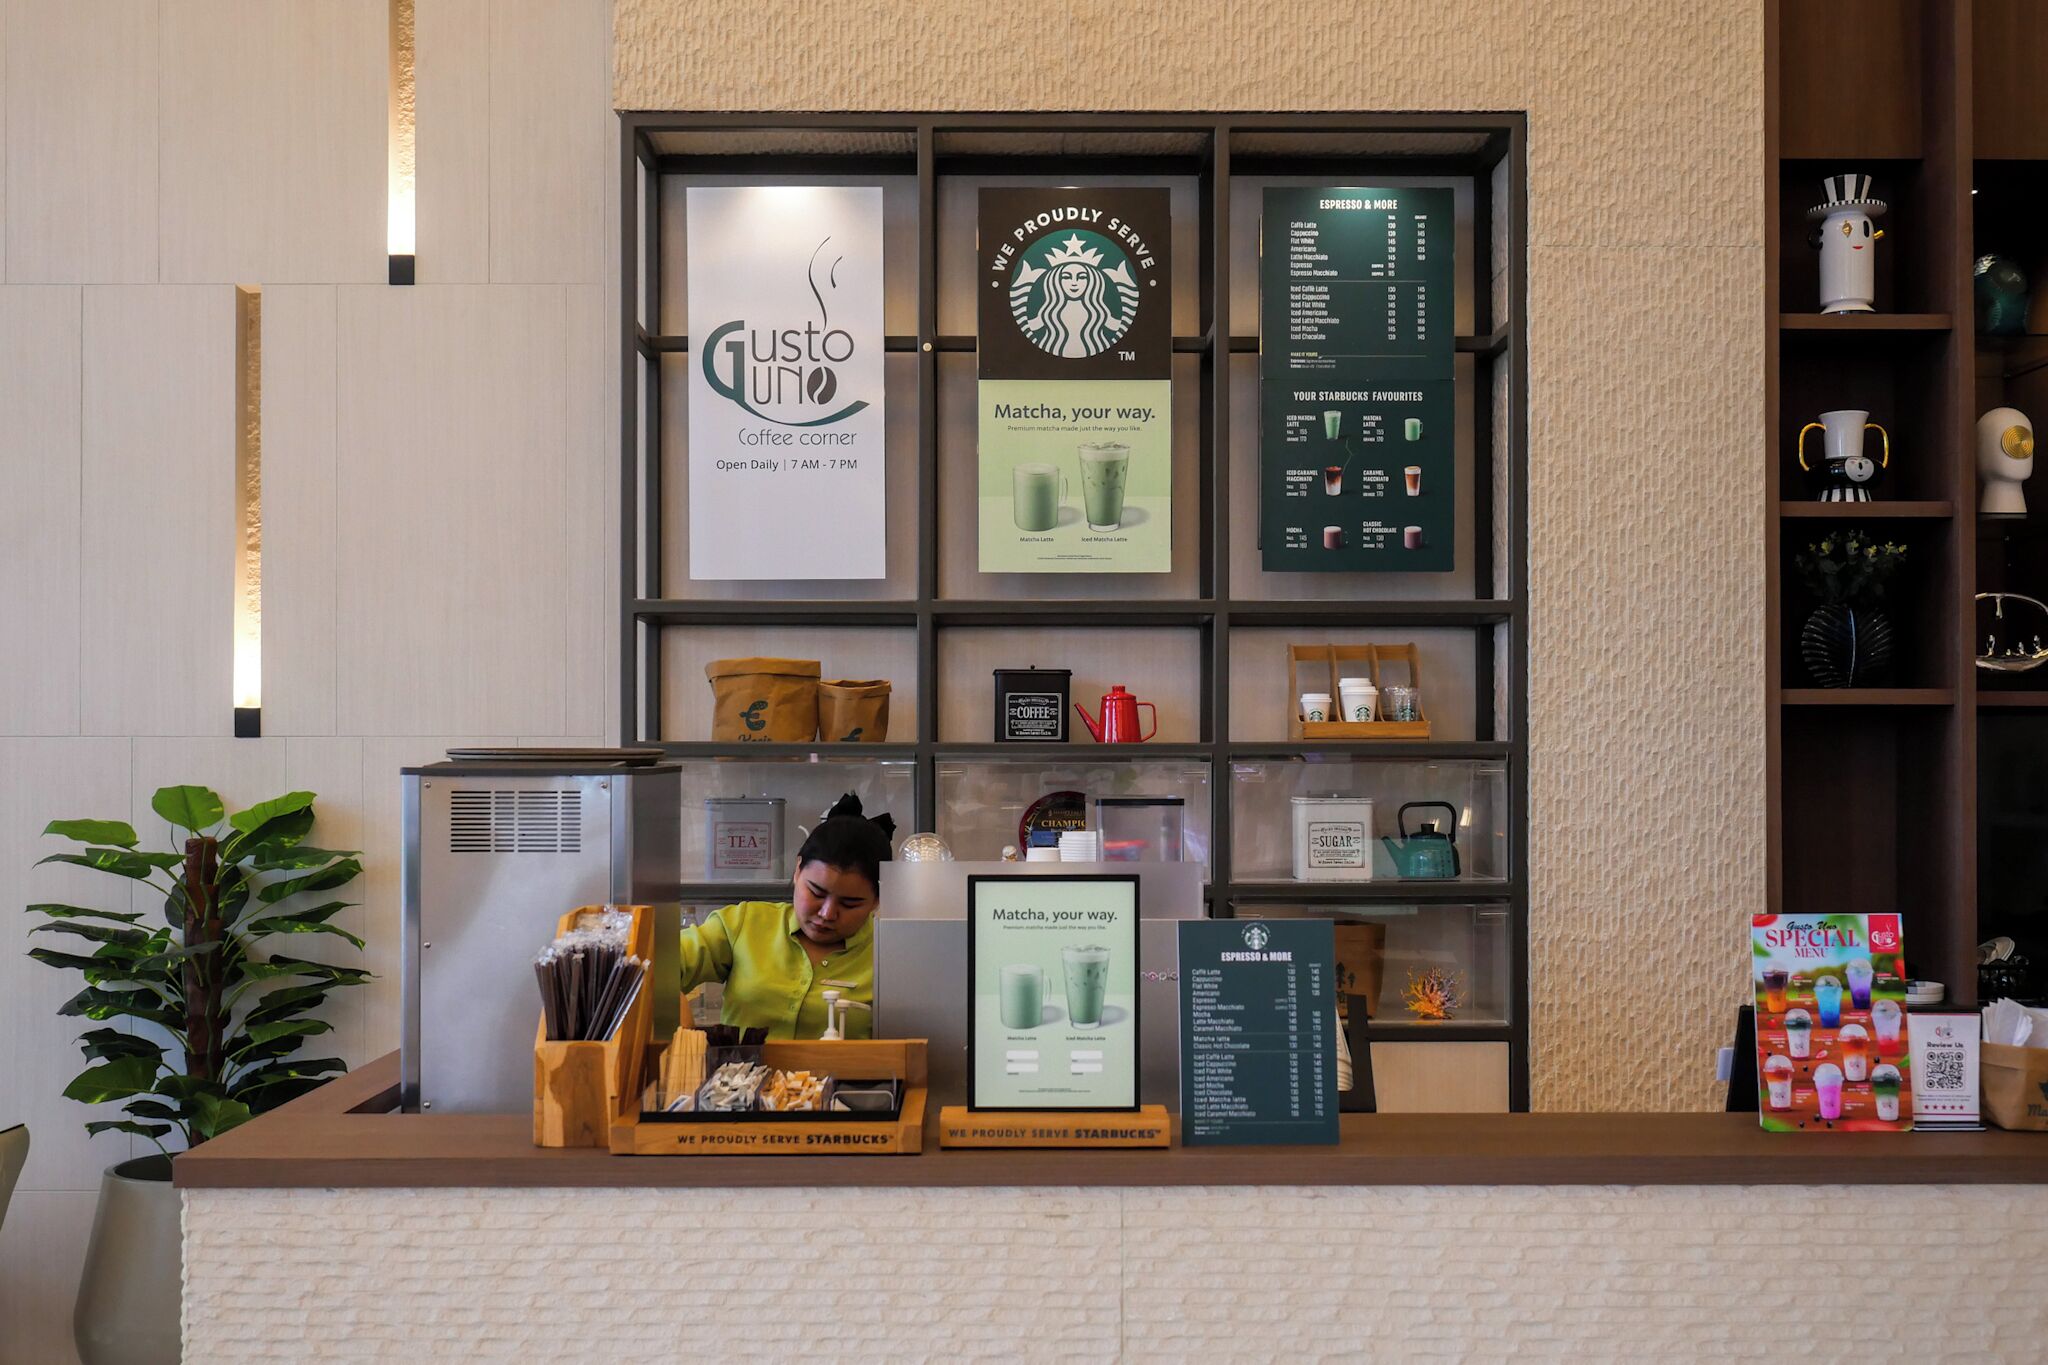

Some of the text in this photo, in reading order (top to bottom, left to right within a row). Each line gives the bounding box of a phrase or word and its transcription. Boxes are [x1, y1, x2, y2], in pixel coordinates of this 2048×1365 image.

[1320, 199, 1398, 210] ESPRESSO & MORE
[992, 207, 1155, 270] WE PROUDLY SERVE
[702, 320, 854, 401] Gusto
[1118, 352, 1136, 361] TM
[1294, 391, 1423, 401] YOUR STARBUCKS FAVOURITES
[995, 403, 1155, 422] Matcha, your way.
[739, 428, 858, 445] Coffee corner
[717, 460, 747, 471] Open
[751, 459, 779, 472] Daily
[791, 460, 798, 469] 7
[801, 460, 820, 469] AM
[830, 460, 837, 469] 7
[840, 460, 858, 469] PM
[1017, 706, 1050, 718] COFFEE
[728, 836, 758, 848] TEA
[1320, 836, 1353, 848] SUGAR
[993, 908, 1118, 923] Matcha, your way.
[1786, 921, 1838, 931] Gusto Uno
[1765, 930, 1860, 947] SPECIAL
[1221, 952, 1261, 961] ESPRESSO
[1270, 952, 1293, 961] MORE
[1795, 948, 1829, 958] MENU
[677, 1135, 695, 1144] WE
[702, 1135, 756, 1144] PROUDLY
[762, 1135, 800, 1144] SERVE
[949, 1129, 967, 1138] WE
[972, 1129, 1026, 1138] PROUDLY
[1031, 1129, 1069, 1138] SERVE
